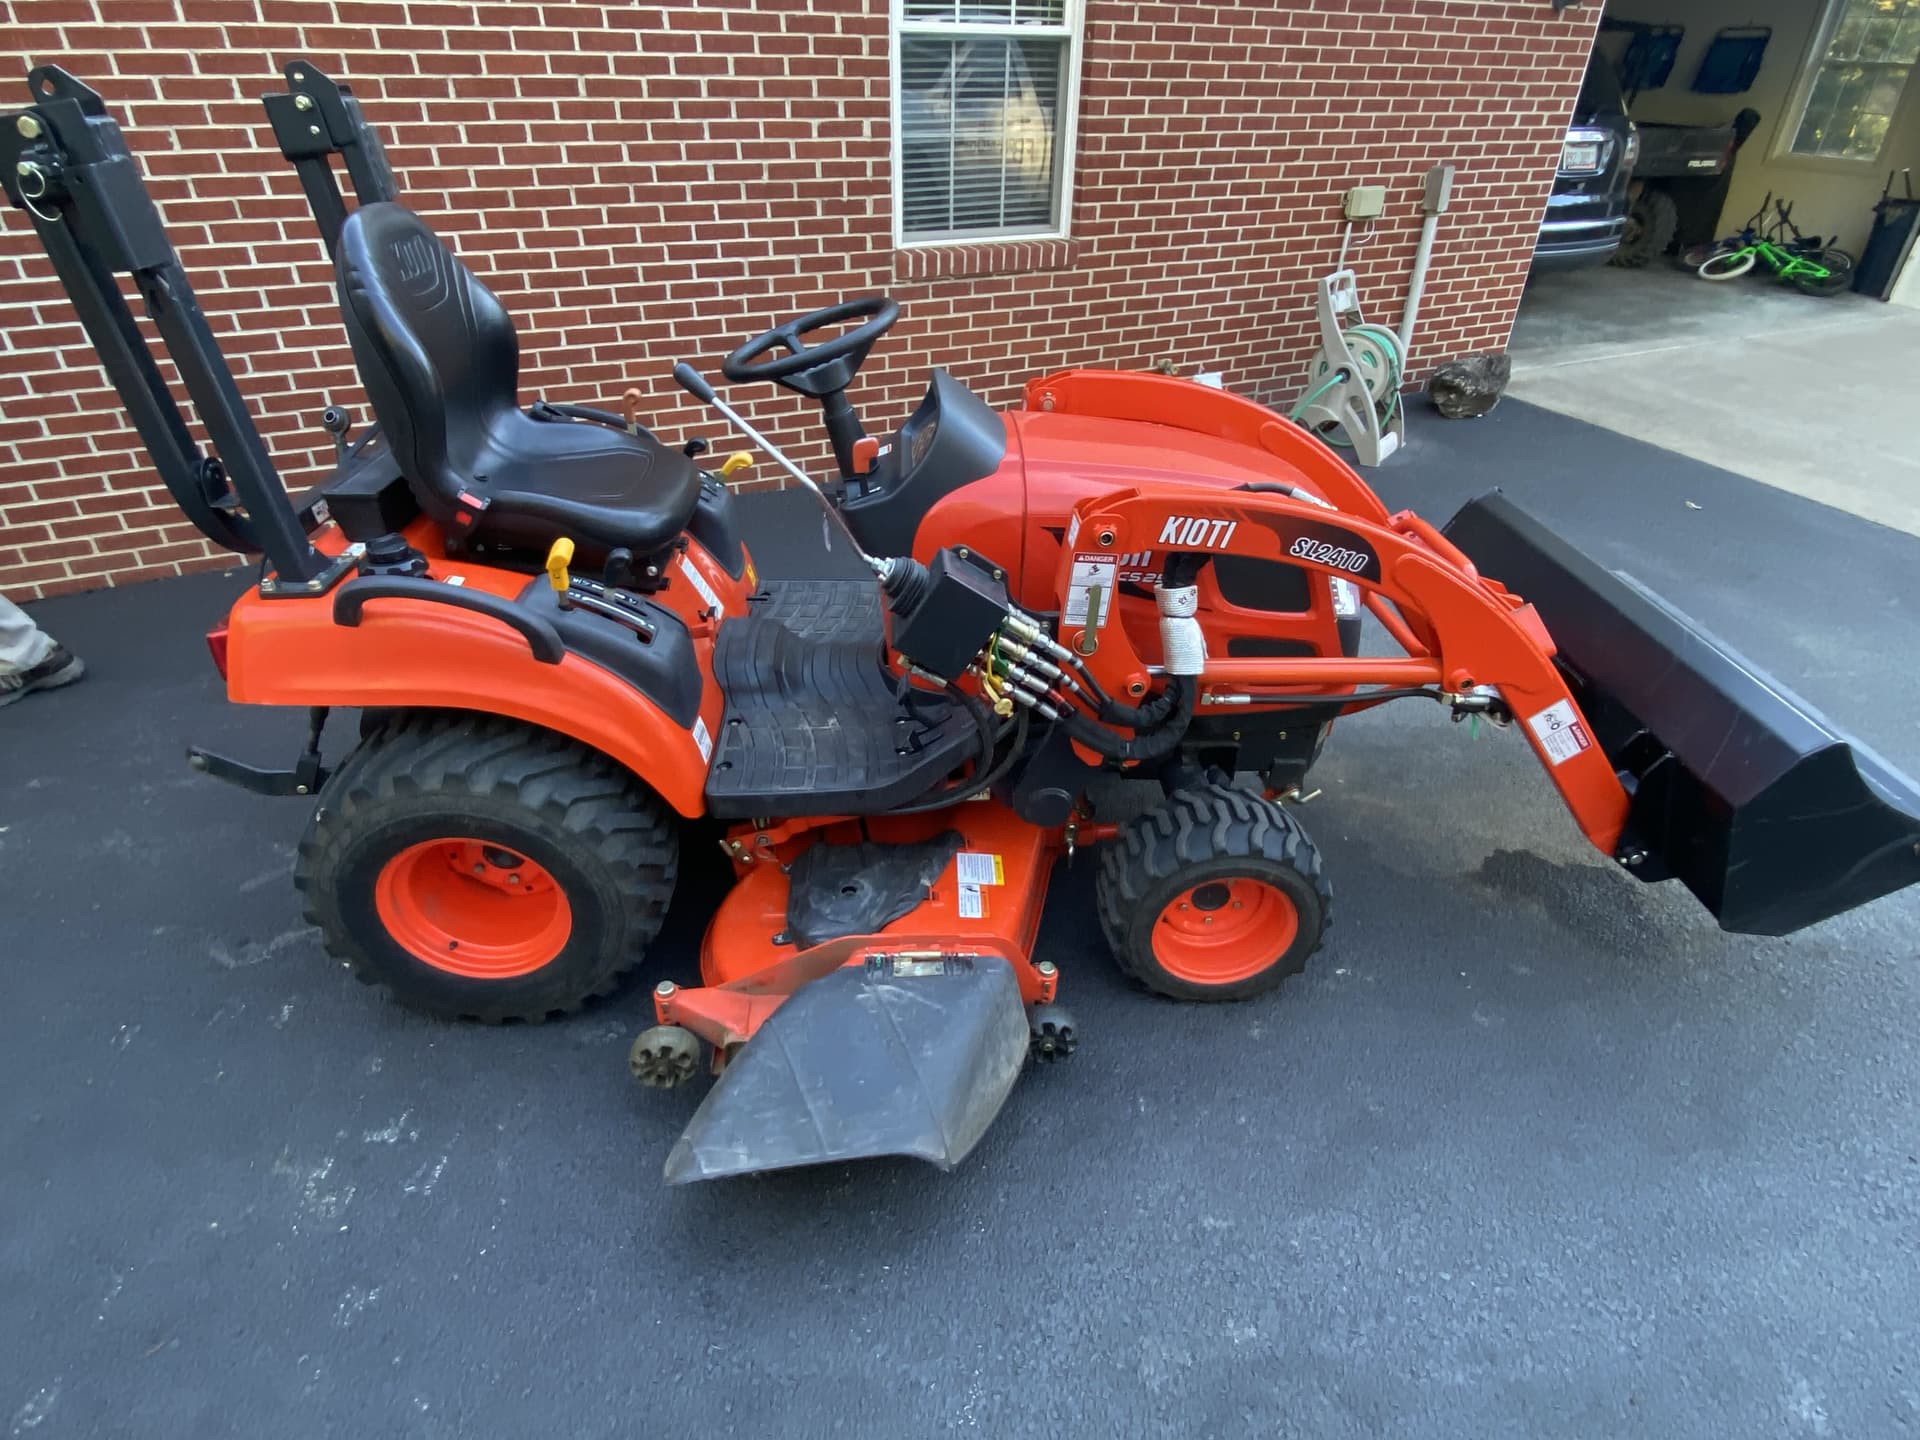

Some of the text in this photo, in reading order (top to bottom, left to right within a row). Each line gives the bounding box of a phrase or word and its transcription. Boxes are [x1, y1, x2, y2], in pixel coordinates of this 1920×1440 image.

[1158, 515, 1238, 549] KIOTI
[1084, 555, 1114, 563] DANGER
[1289, 536, 1369, 573] SL2410
